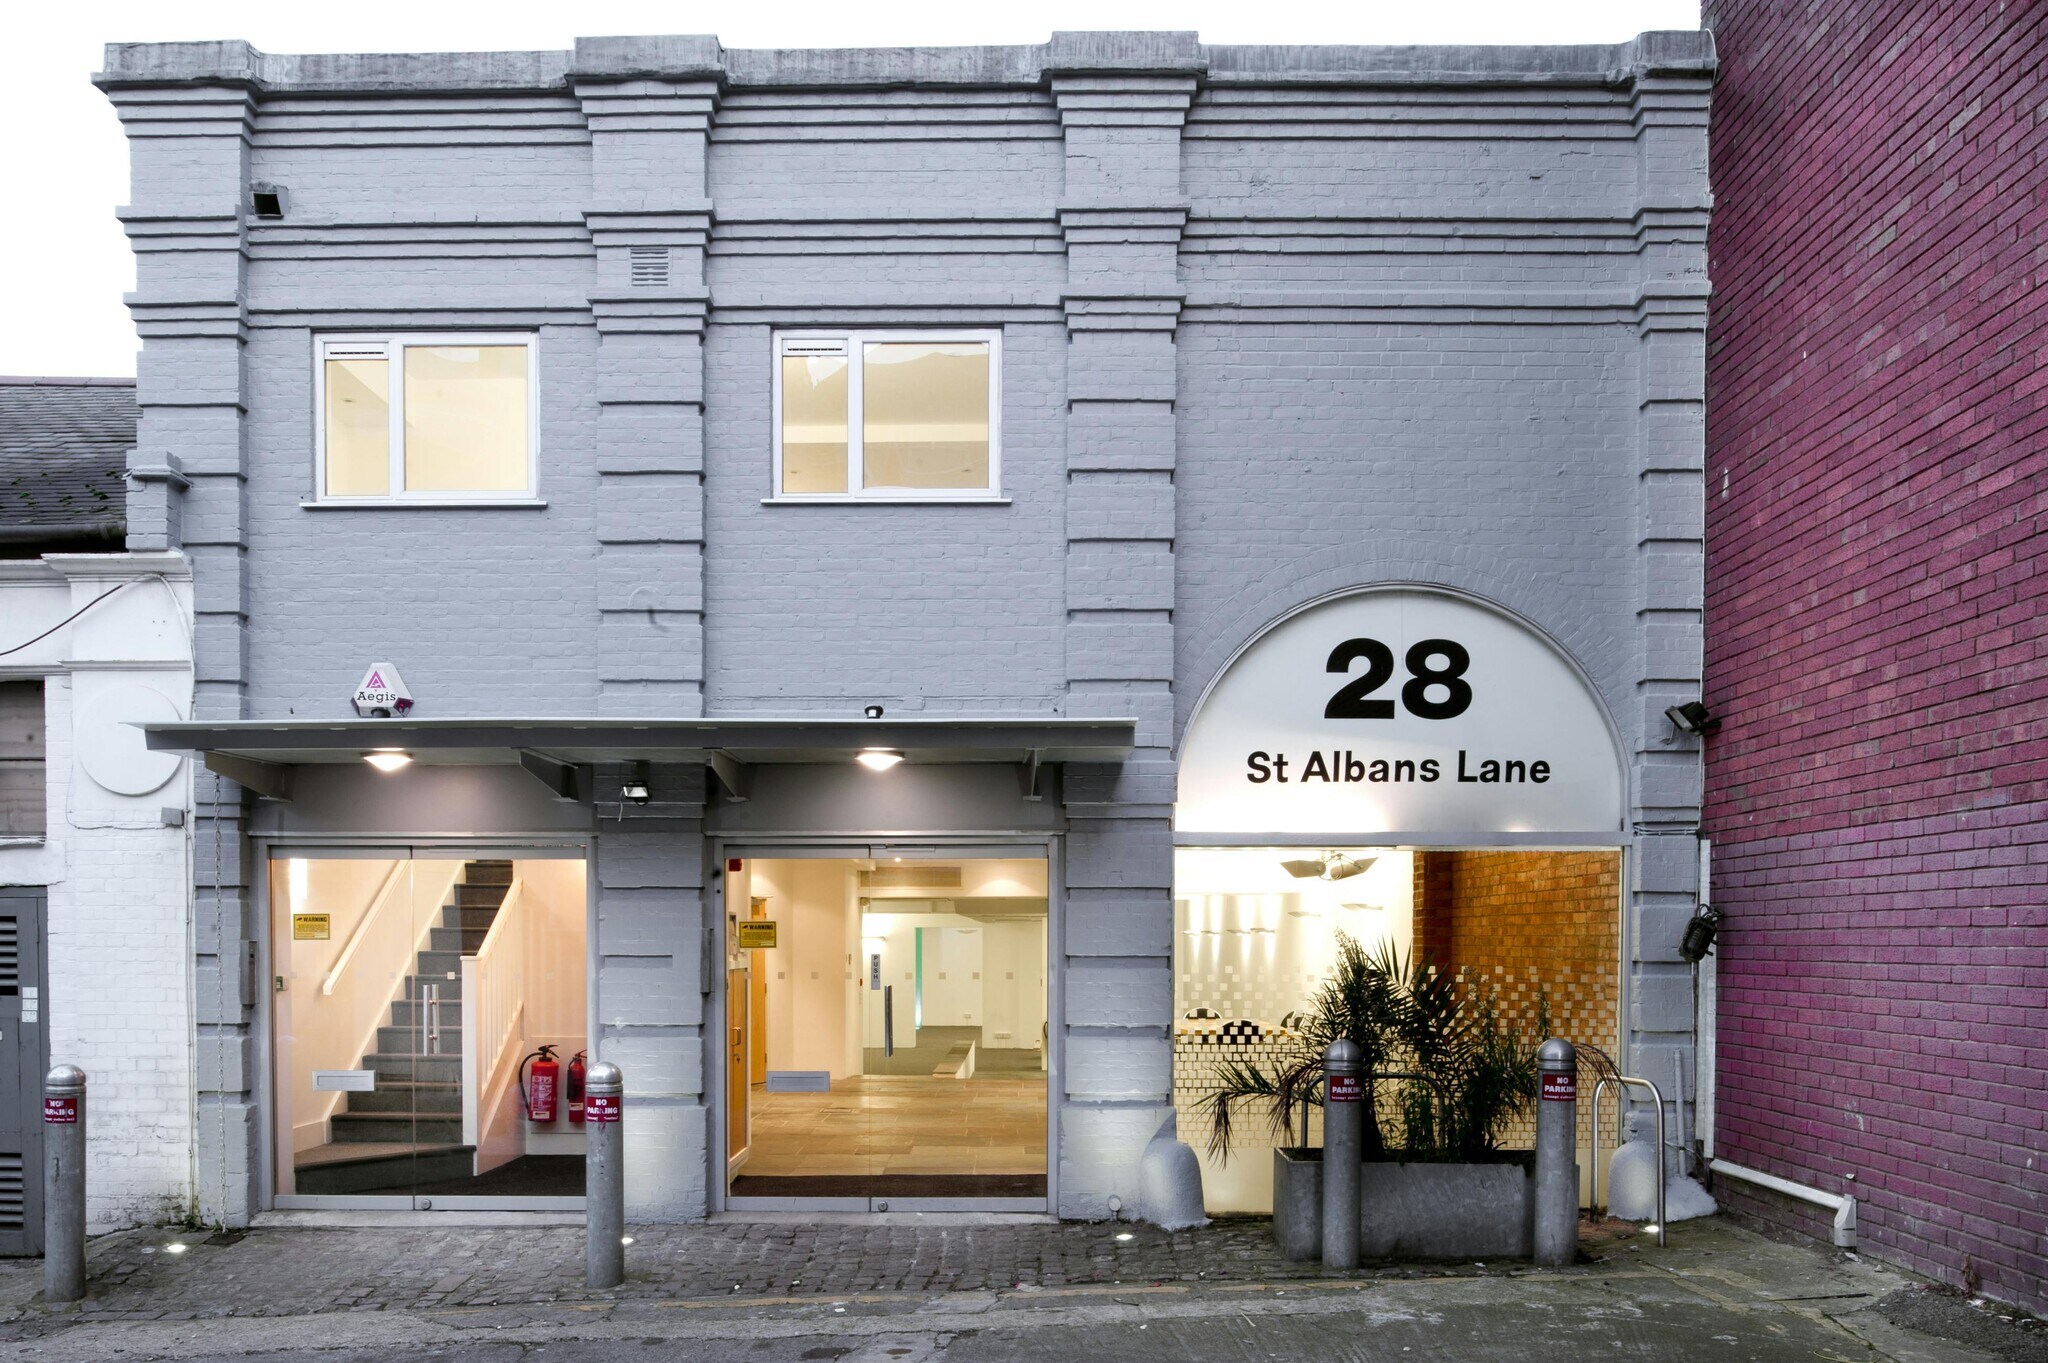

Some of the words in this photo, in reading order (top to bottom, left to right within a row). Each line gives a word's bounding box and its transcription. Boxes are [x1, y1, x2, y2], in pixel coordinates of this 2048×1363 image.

[1324, 637, 1473, 720] 28
[356, 691, 396, 703] Aegis
[1246, 750, 1289, 784] St
[1300, 750, 1440, 784] Albans
[1457, 749, 1551, 783] Lane
